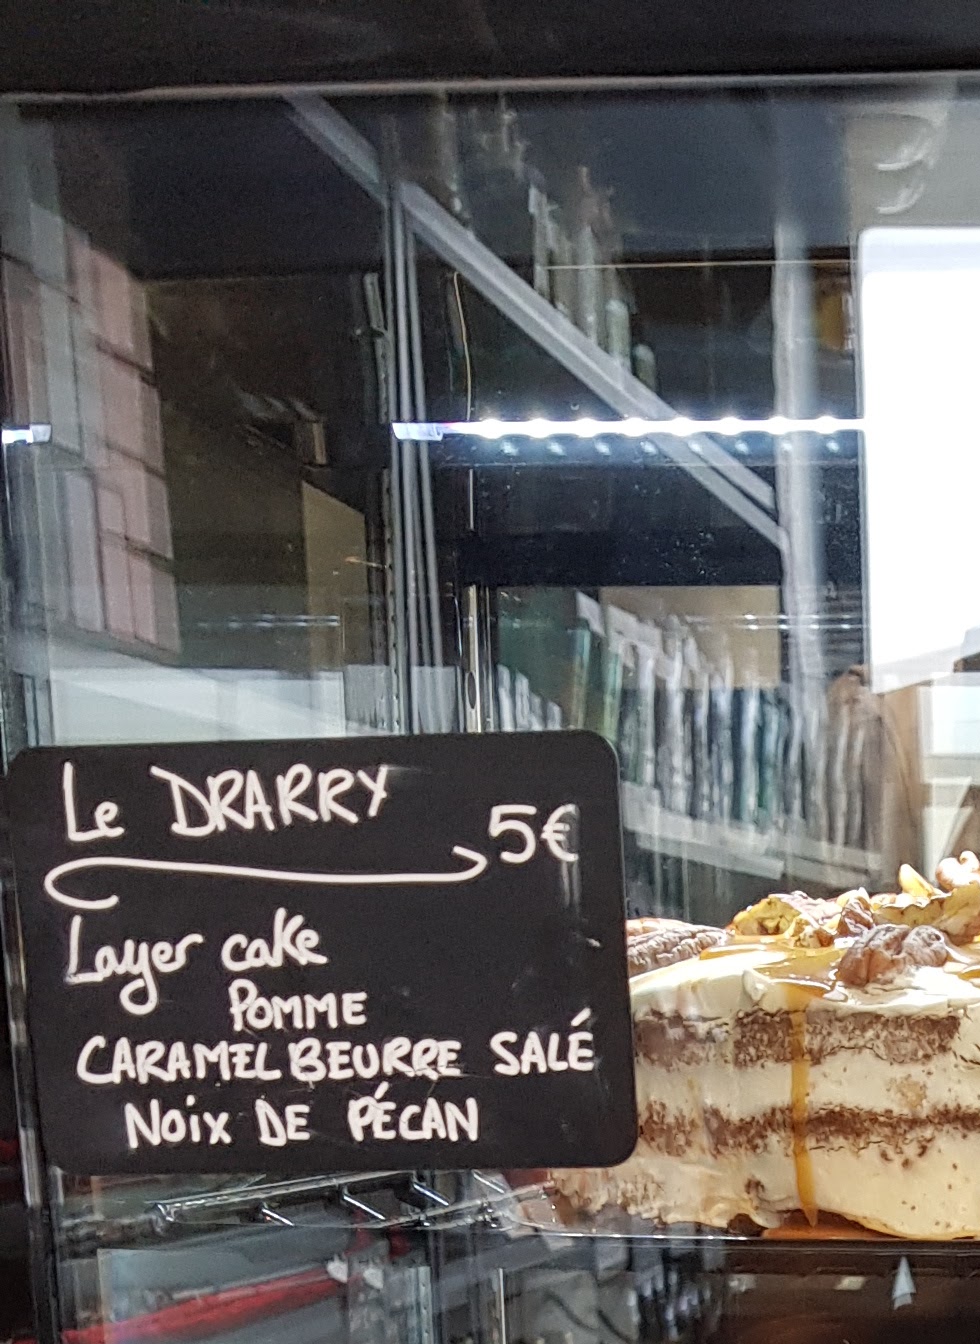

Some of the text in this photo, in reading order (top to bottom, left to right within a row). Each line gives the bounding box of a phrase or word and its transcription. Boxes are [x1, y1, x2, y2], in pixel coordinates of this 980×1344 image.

[63, 762, 389, 841] Le DRARRY
[489, 804, 578, 862] 5€
[66, 915, 203, 1015] Layer
[229, 979, 367, 1031] POMME
[77, 1008, 594, 1084] CARAMEL BEURRE SALÉ
[256, 1099, 310, 1146] DE
[348, 1081, 478, 1141] PÉCAN
